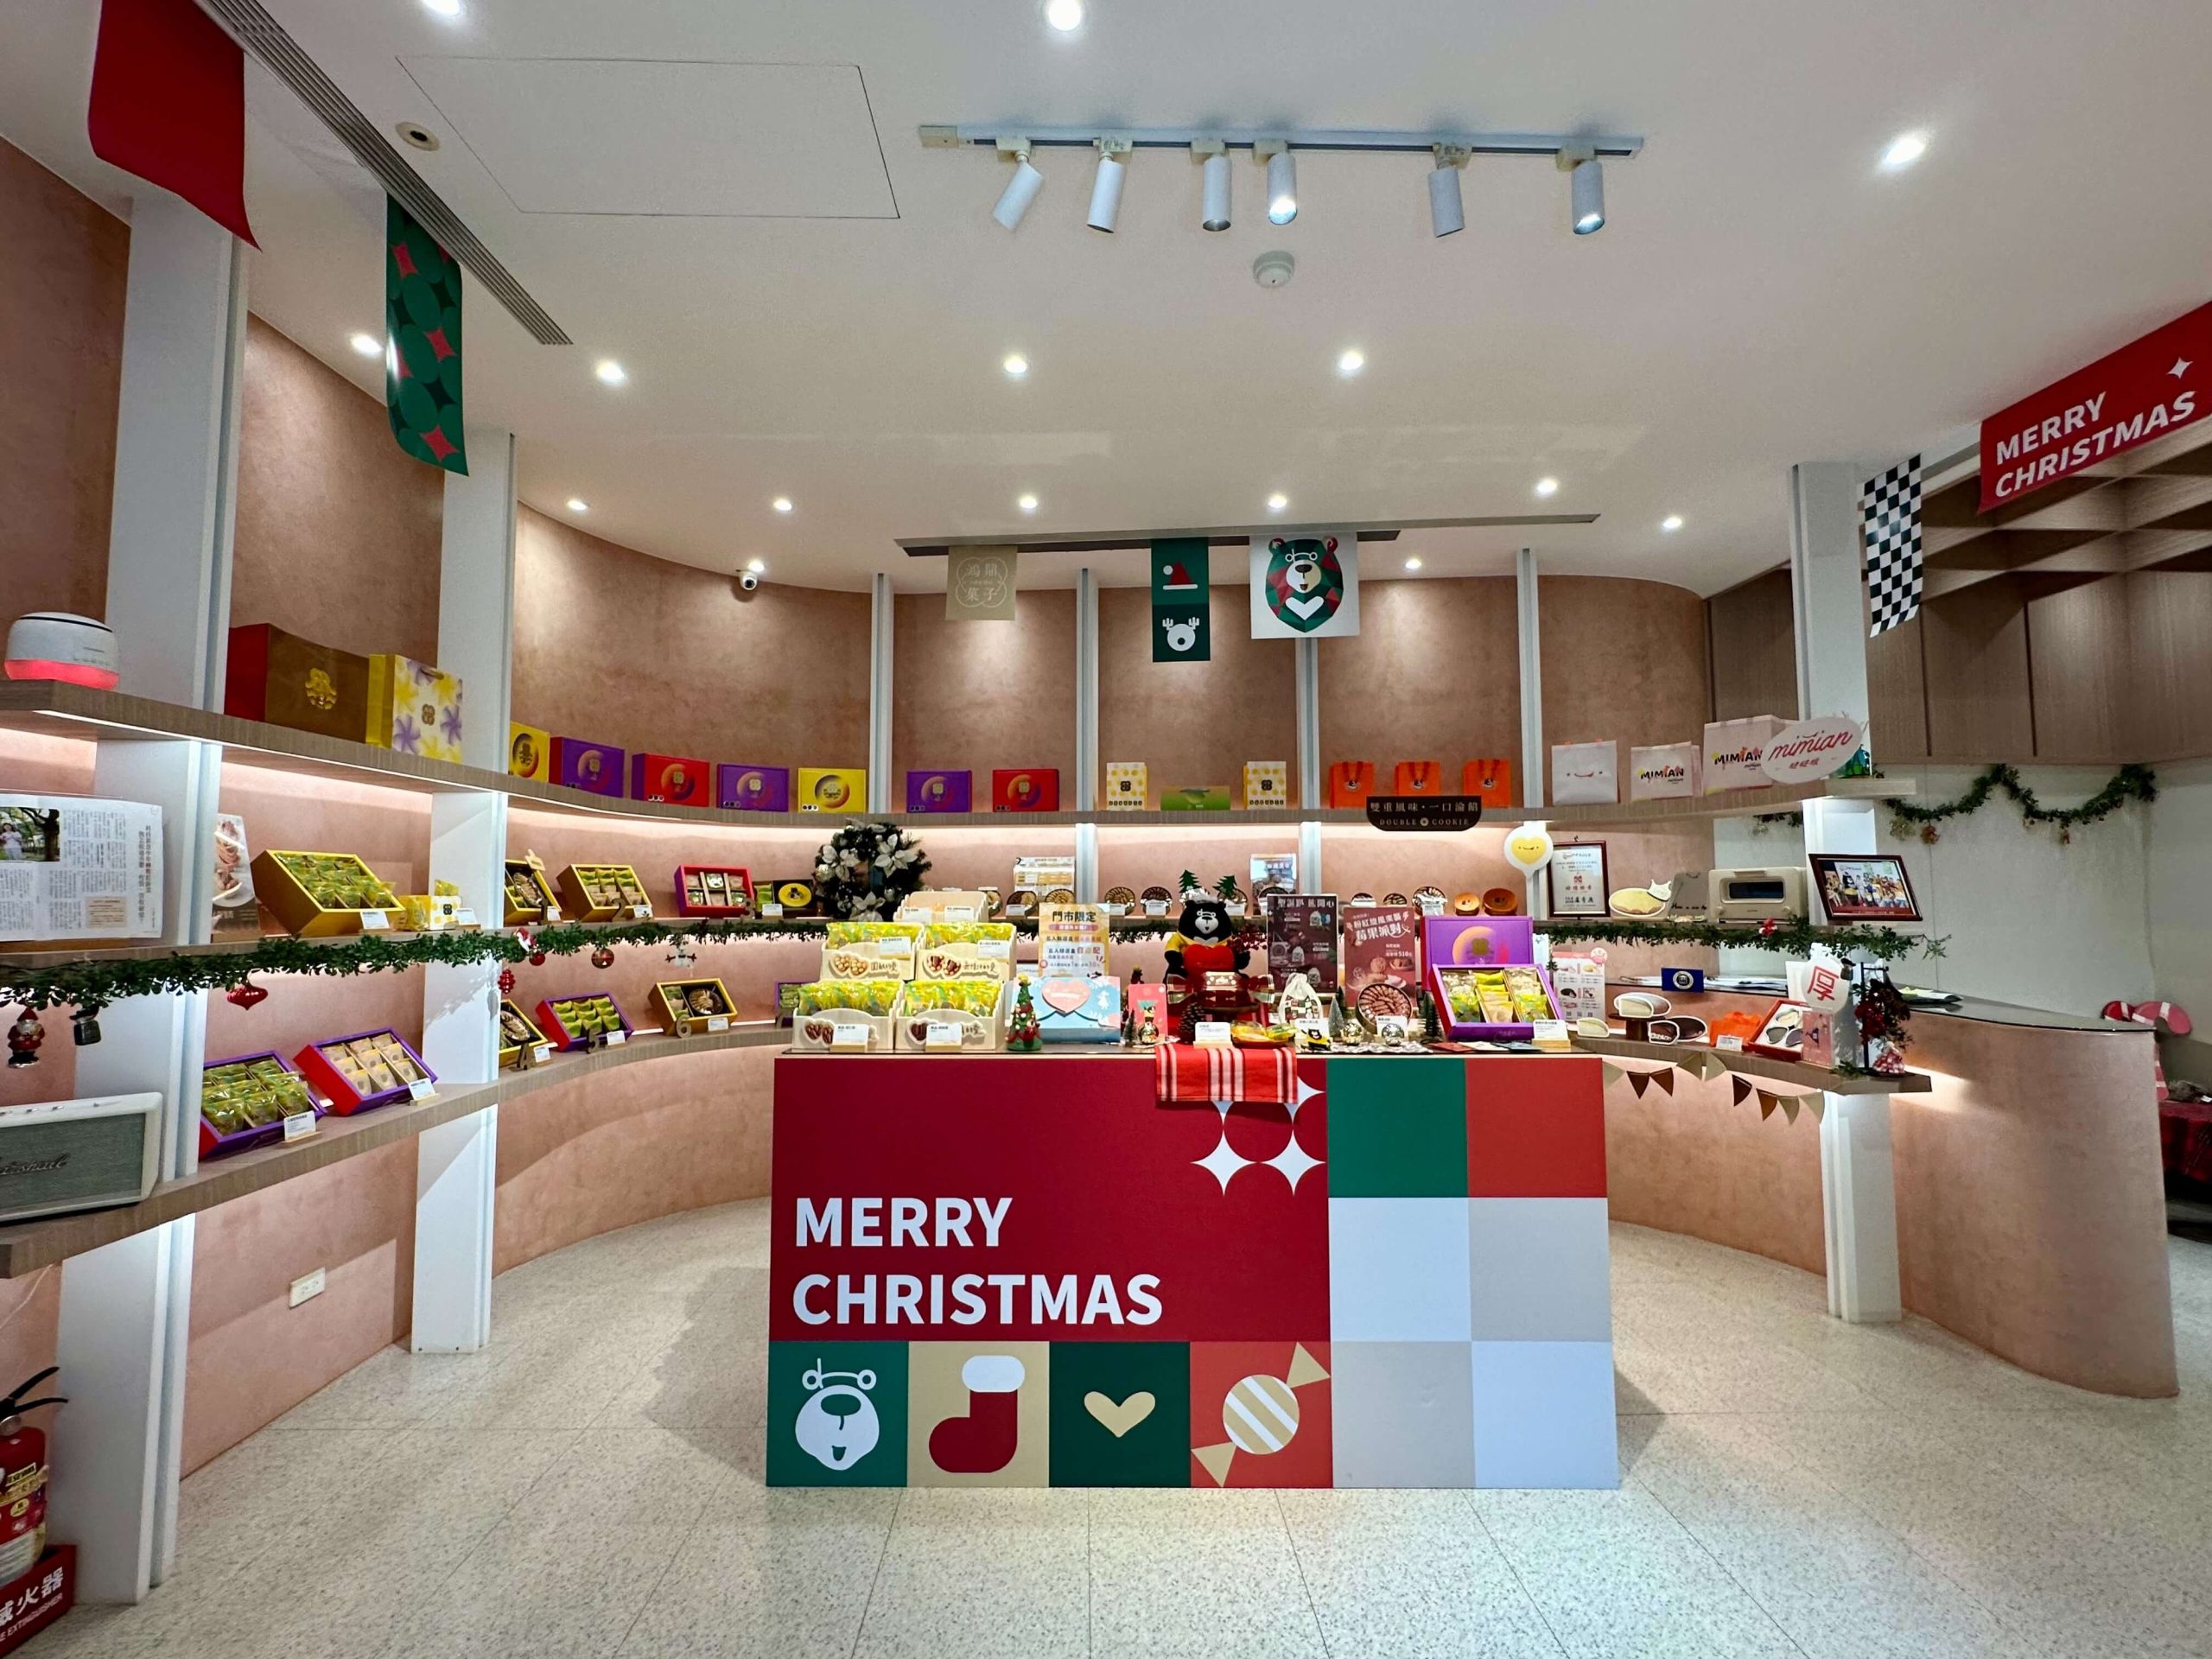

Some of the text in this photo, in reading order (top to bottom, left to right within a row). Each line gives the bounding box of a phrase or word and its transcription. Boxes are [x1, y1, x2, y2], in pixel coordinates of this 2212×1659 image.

[1994, 391, 2196, 497] CHRISTMAS
[1996, 391, 2106, 466] MERRY
[1640, 767, 1684, 779] MIMIAN
[1052, 911, 1096, 923] 門市限定
[796, 1197, 1013, 1247] MERRY
[792, 1274, 1163, 1325] CHRISTMAS
